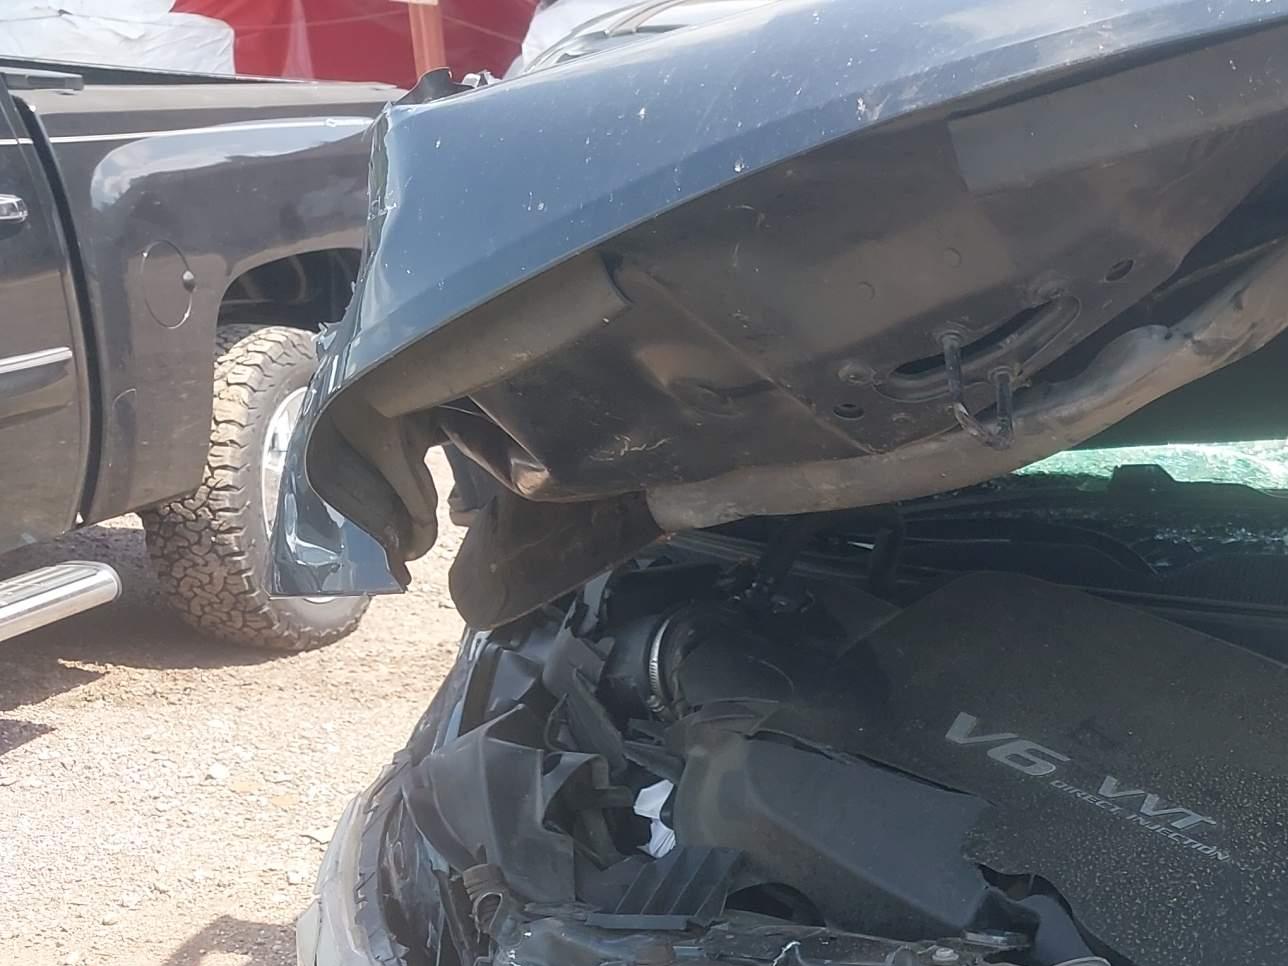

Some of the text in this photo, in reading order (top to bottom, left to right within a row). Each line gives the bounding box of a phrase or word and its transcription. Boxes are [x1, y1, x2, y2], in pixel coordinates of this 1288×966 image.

[945, 711, 1217, 830] V6 VVT
[1050, 779, 1231, 862] DIRECT INJECTION
